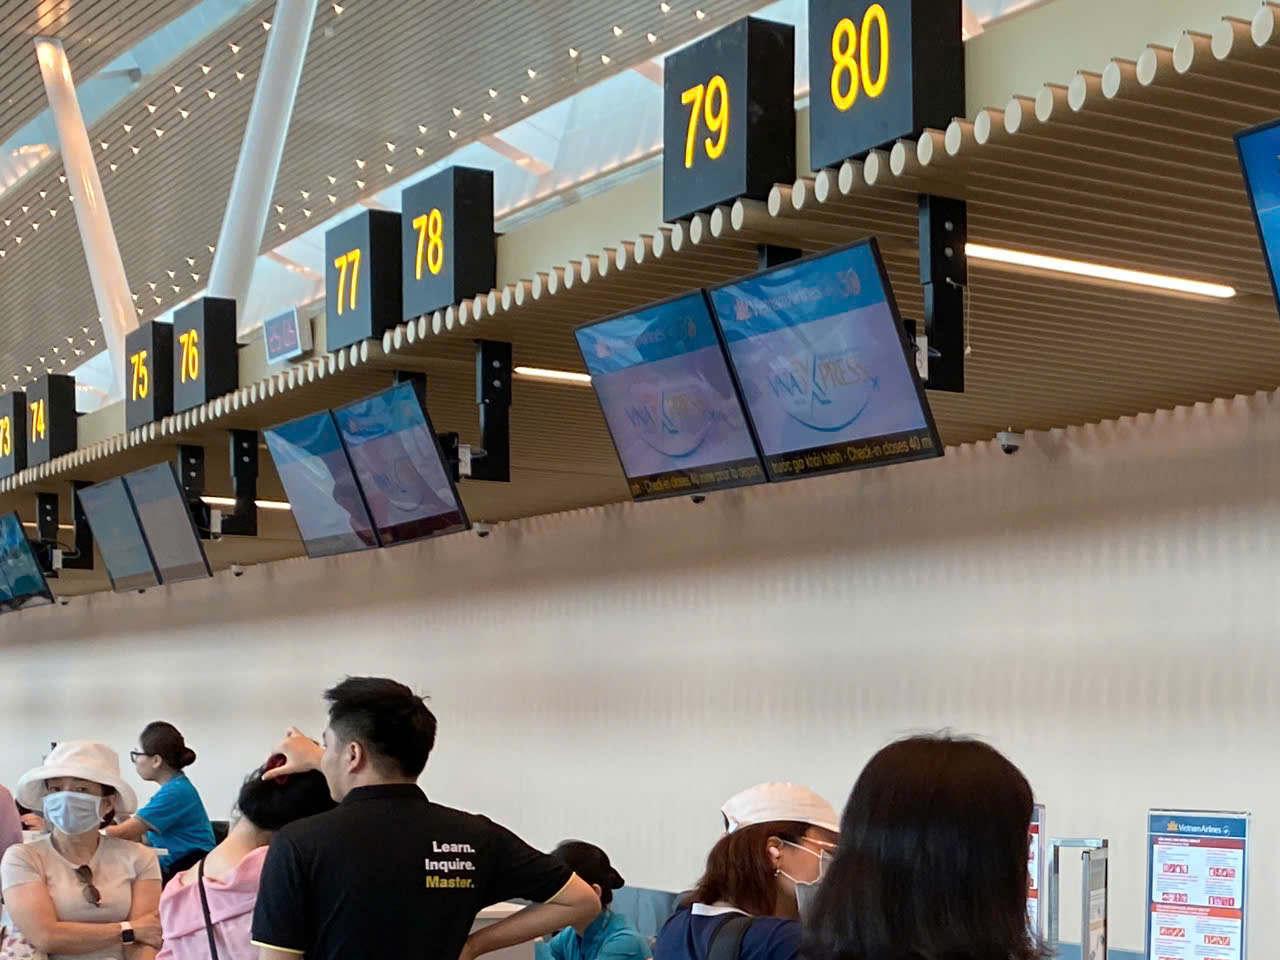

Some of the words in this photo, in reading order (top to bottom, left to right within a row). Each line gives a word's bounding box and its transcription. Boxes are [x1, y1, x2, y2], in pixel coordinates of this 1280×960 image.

[831, 3, 889, 111] 80
[681, 75, 729, 168] 79
[413, 208, 443, 280] 78
[335, 249, 360, 315] 77
[131, 351, 148, 401] 75
[179, 329, 198, 383] 76
[30, 399, 45, 443] 74
[425, 858, 475, 872] Inquire.
[432, 841, 475, 853] Learn.
[426, 876, 475, 888] Master.
